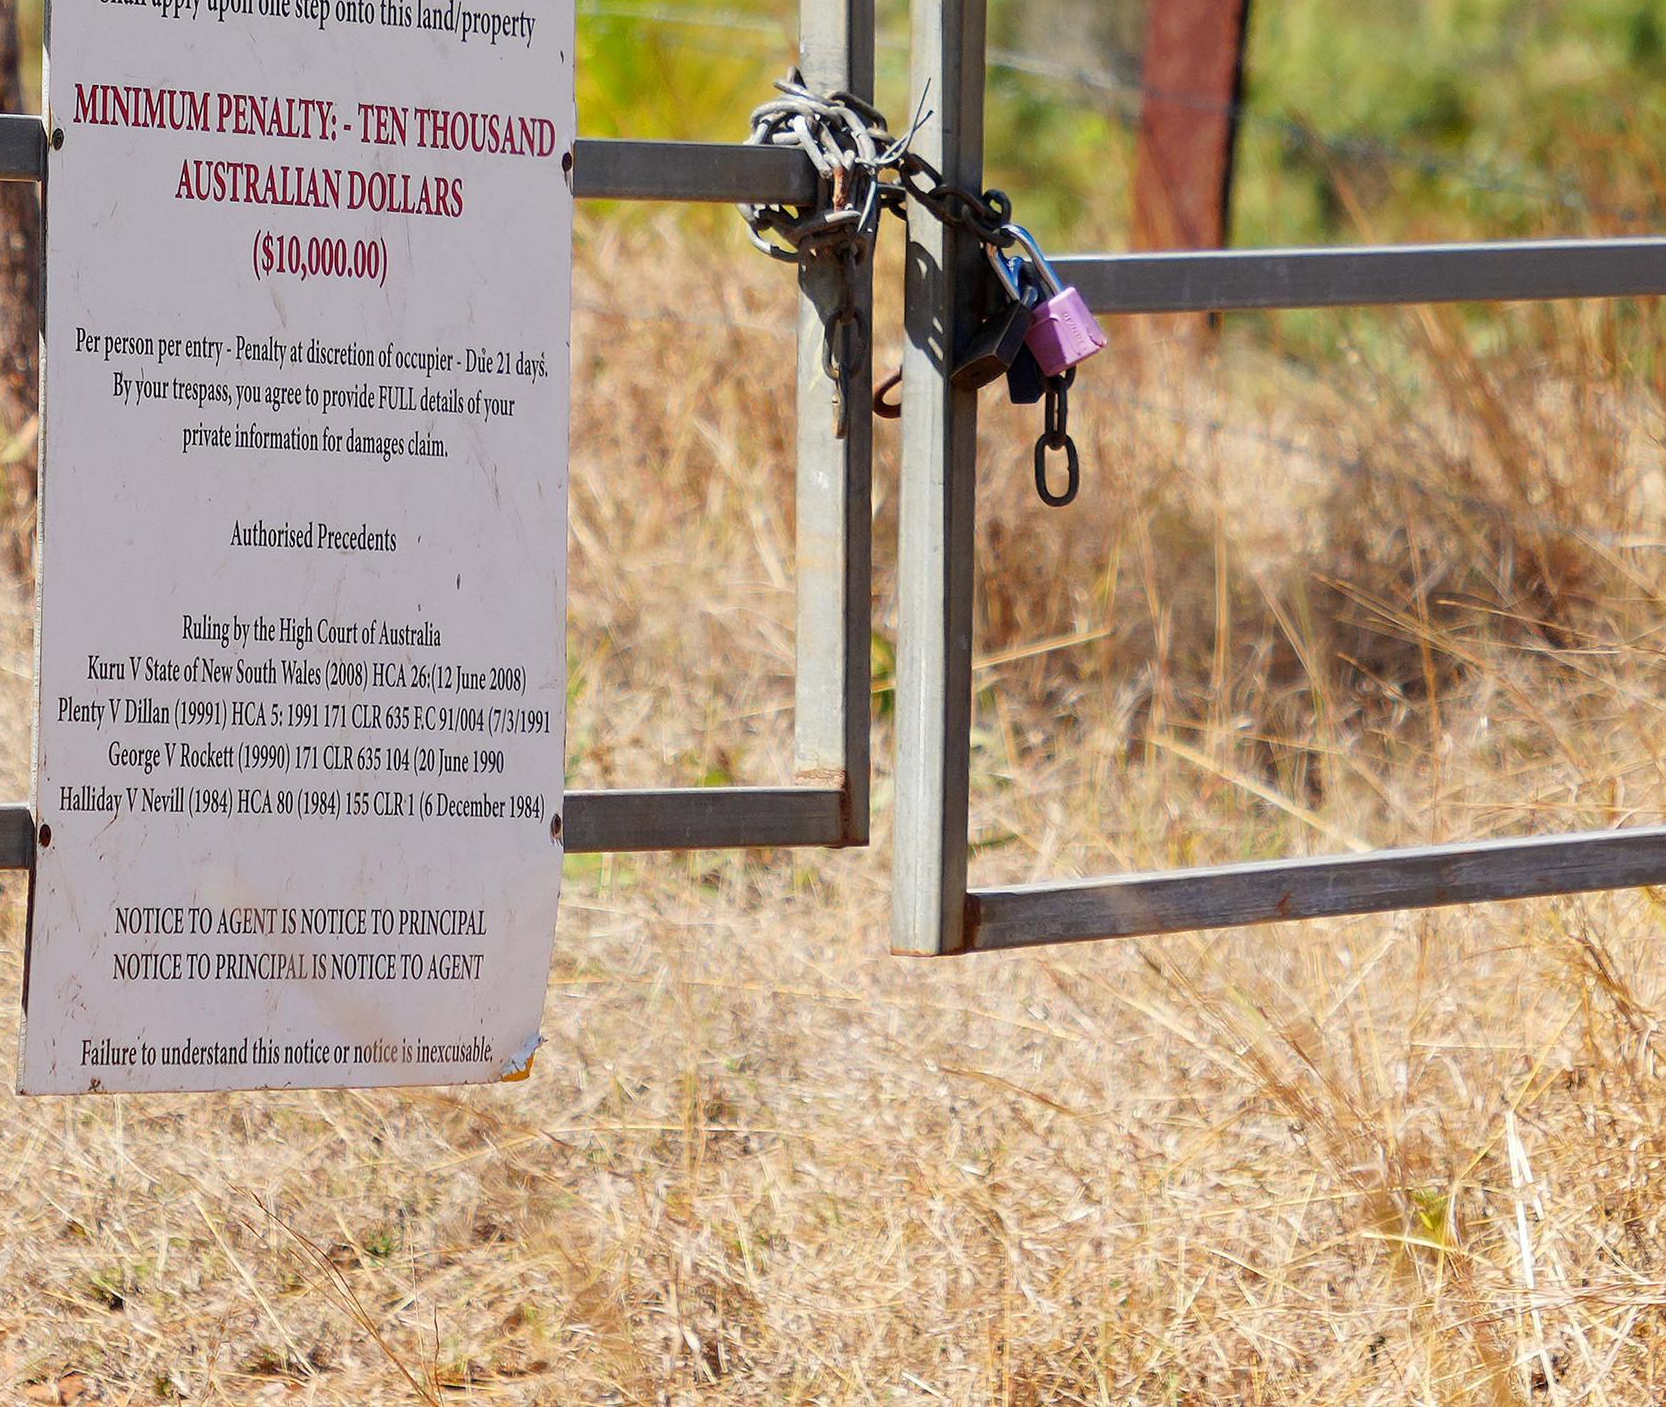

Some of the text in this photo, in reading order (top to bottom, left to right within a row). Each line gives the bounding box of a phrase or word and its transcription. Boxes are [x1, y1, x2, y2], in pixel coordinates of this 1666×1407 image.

[72, 82, 211, 132] MINIMUM
[216, 92, 337, 142] PENALTY:
[357, 102, 409, 147] TEN
[413, 106, 556, 158] THOUSAND
[174, 158, 464, 218] AUSTRALIAN DOLLARS
[253, 229, 388, 288] ($10,000.00)
[75, 326, 101, 353] Per
[103, 335, 155, 362] person
[157, 338, 182, 365] per
[185, 335, 224, 368] entry
[235, 335, 288, 371] Penalty
[289, 341, 304, 364] at
[306, 338, 375, 367] discretion
[378, 343, 394, 368] of
[395, 346, 454, 379] occupier
[465, 348, 494, 374] Due
[496, 351, 511, 375] 21
[112, 370, 516, 423] By your trespass, you agree to provide FULL details of your
[182, 421, 448, 463] private information for damages claim.
[229, 519, 397, 552] Authorised Precedents
[181, 614, 442, 651] Ruling by the High Court of Australia
[108, 740, 505, 778] George V Rockett (19990) 171 CLR 635 104 (20 June 1990
[59, 784, 545, 824] Halliday V Nevill (1984) HCA 80 (1984) 155 CLR 1 (6 December 1984)
[114, 907, 487, 936] NOTICE TO AGENT IS NOTICE TO PRINCIPAL
[112, 952, 485, 981] NOTICE TO PRINCIPAL IS NOTICE TO AGENT
[80, 1037, 493, 1067] Failure to understand this notice or notice is inexcusable.
